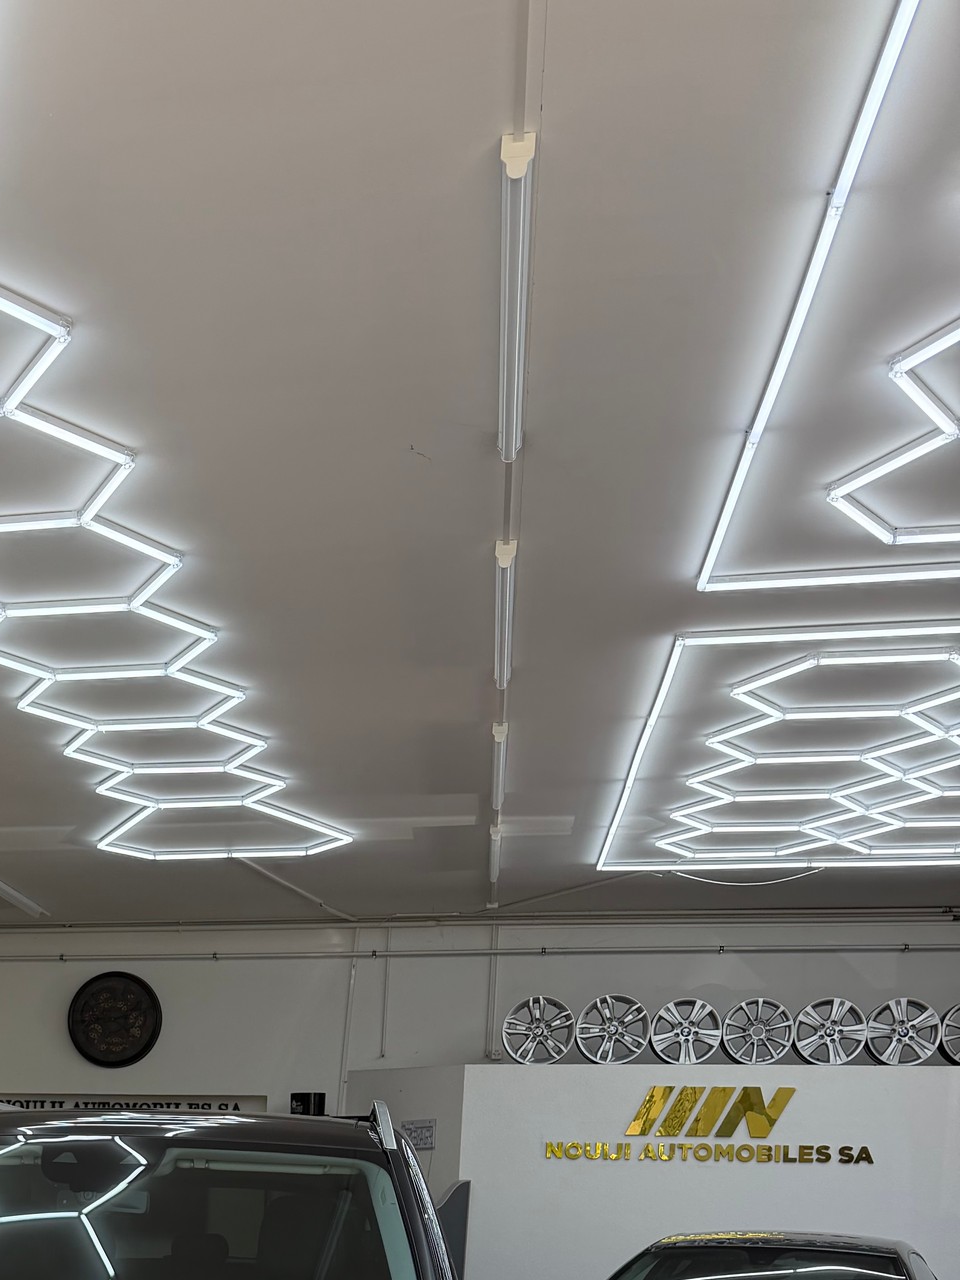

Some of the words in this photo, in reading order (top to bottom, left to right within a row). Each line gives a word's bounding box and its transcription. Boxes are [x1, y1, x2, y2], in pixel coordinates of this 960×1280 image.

[545, 1141, 631, 1161] NOUIJI
[638, 1142, 833, 1164] AUTOMOBILES
[838, 1145, 874, 1165] SA
